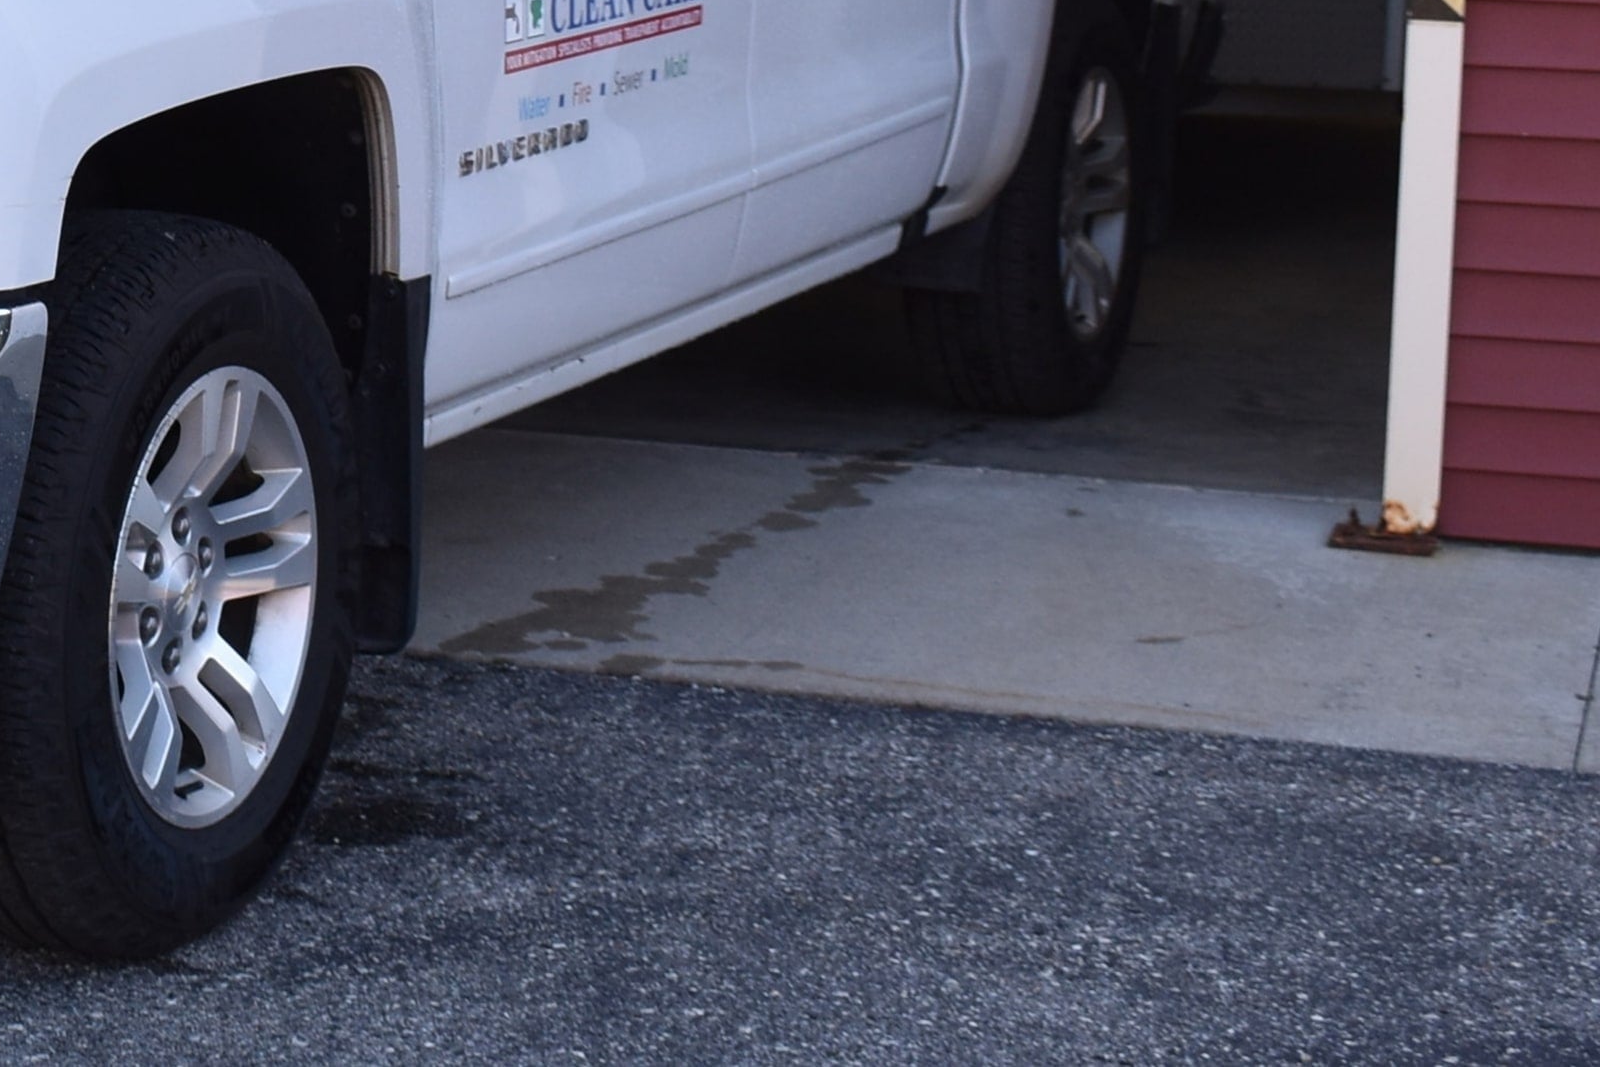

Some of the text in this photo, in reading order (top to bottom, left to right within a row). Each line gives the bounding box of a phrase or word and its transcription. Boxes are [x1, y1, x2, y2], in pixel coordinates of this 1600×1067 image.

[572, 82, 592, 105] Fire
[613, 70, 644, 95] Sewer
[459, 119, 589, 177] SILVERADO
